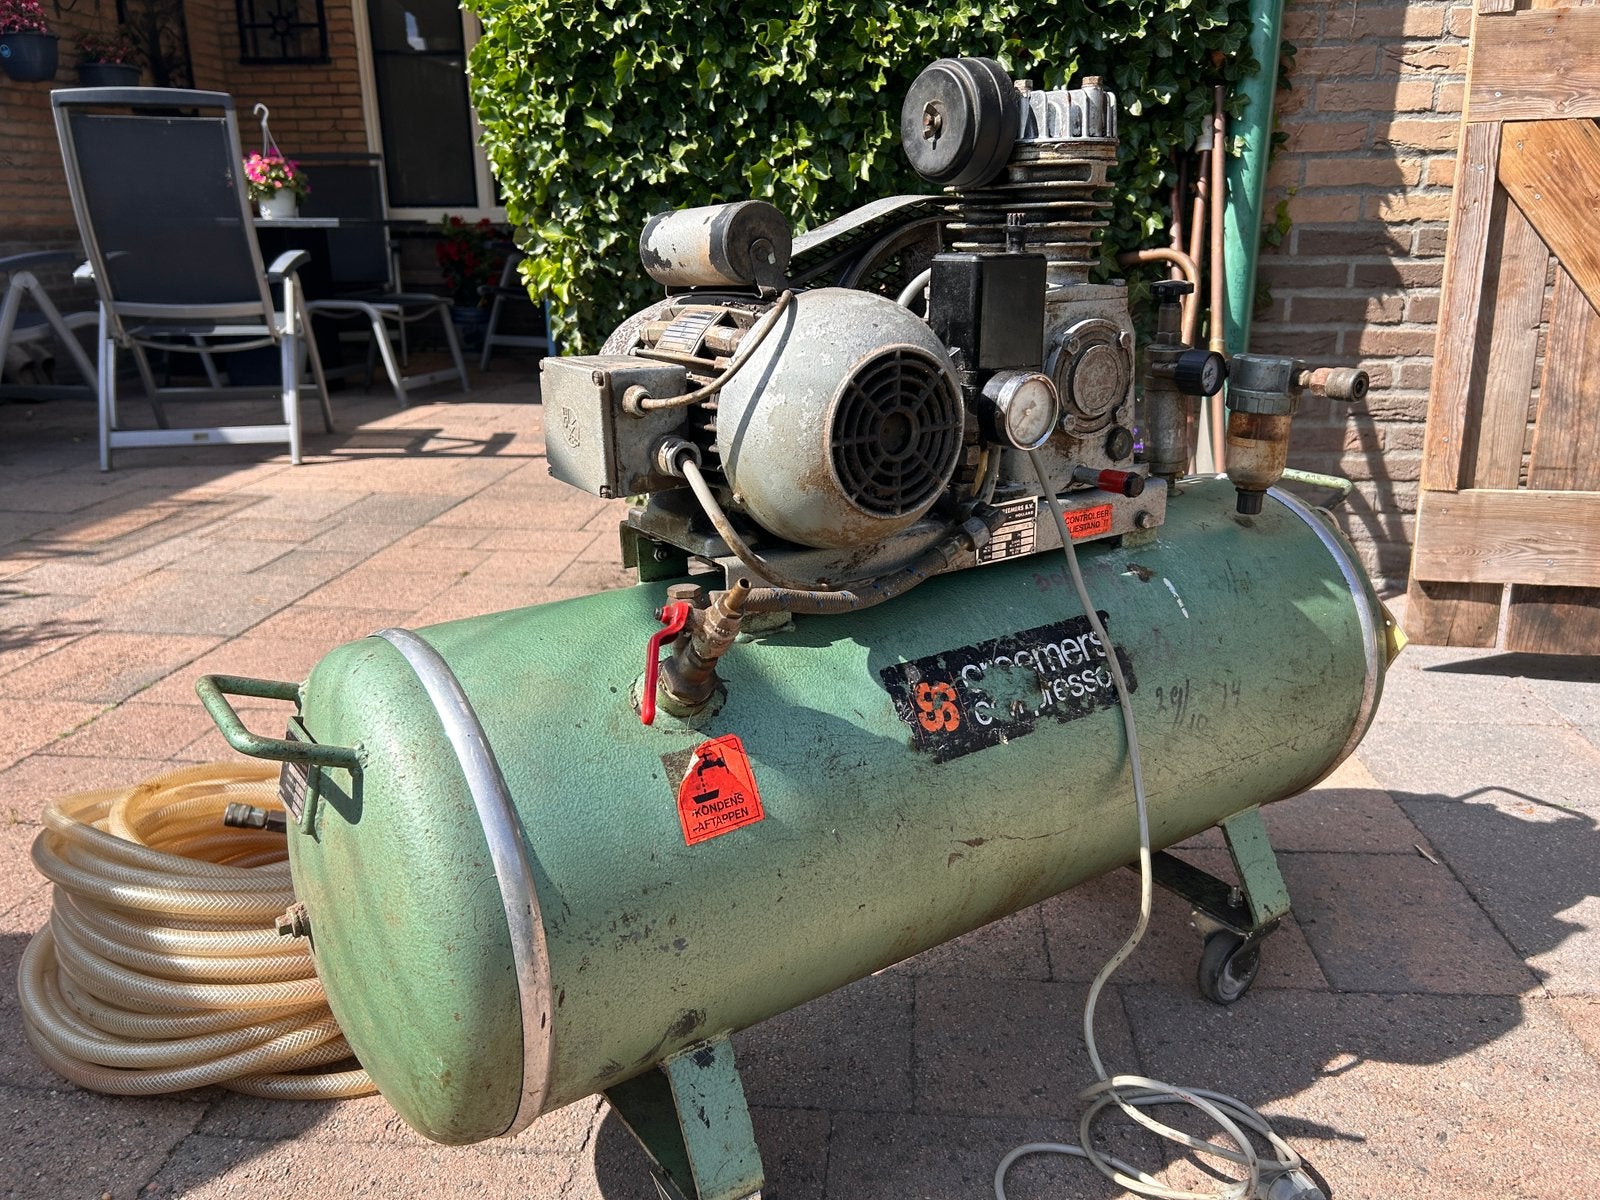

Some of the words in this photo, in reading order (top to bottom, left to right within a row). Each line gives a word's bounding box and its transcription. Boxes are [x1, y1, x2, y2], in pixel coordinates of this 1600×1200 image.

[1065, 509, 1109, 525] CONTROLEER
[1068, 520, 1100, 534] LIESTAND
[693, 793, 745, 818] KONDENS
[697, 806, 749, 833] AFTAPPEN
